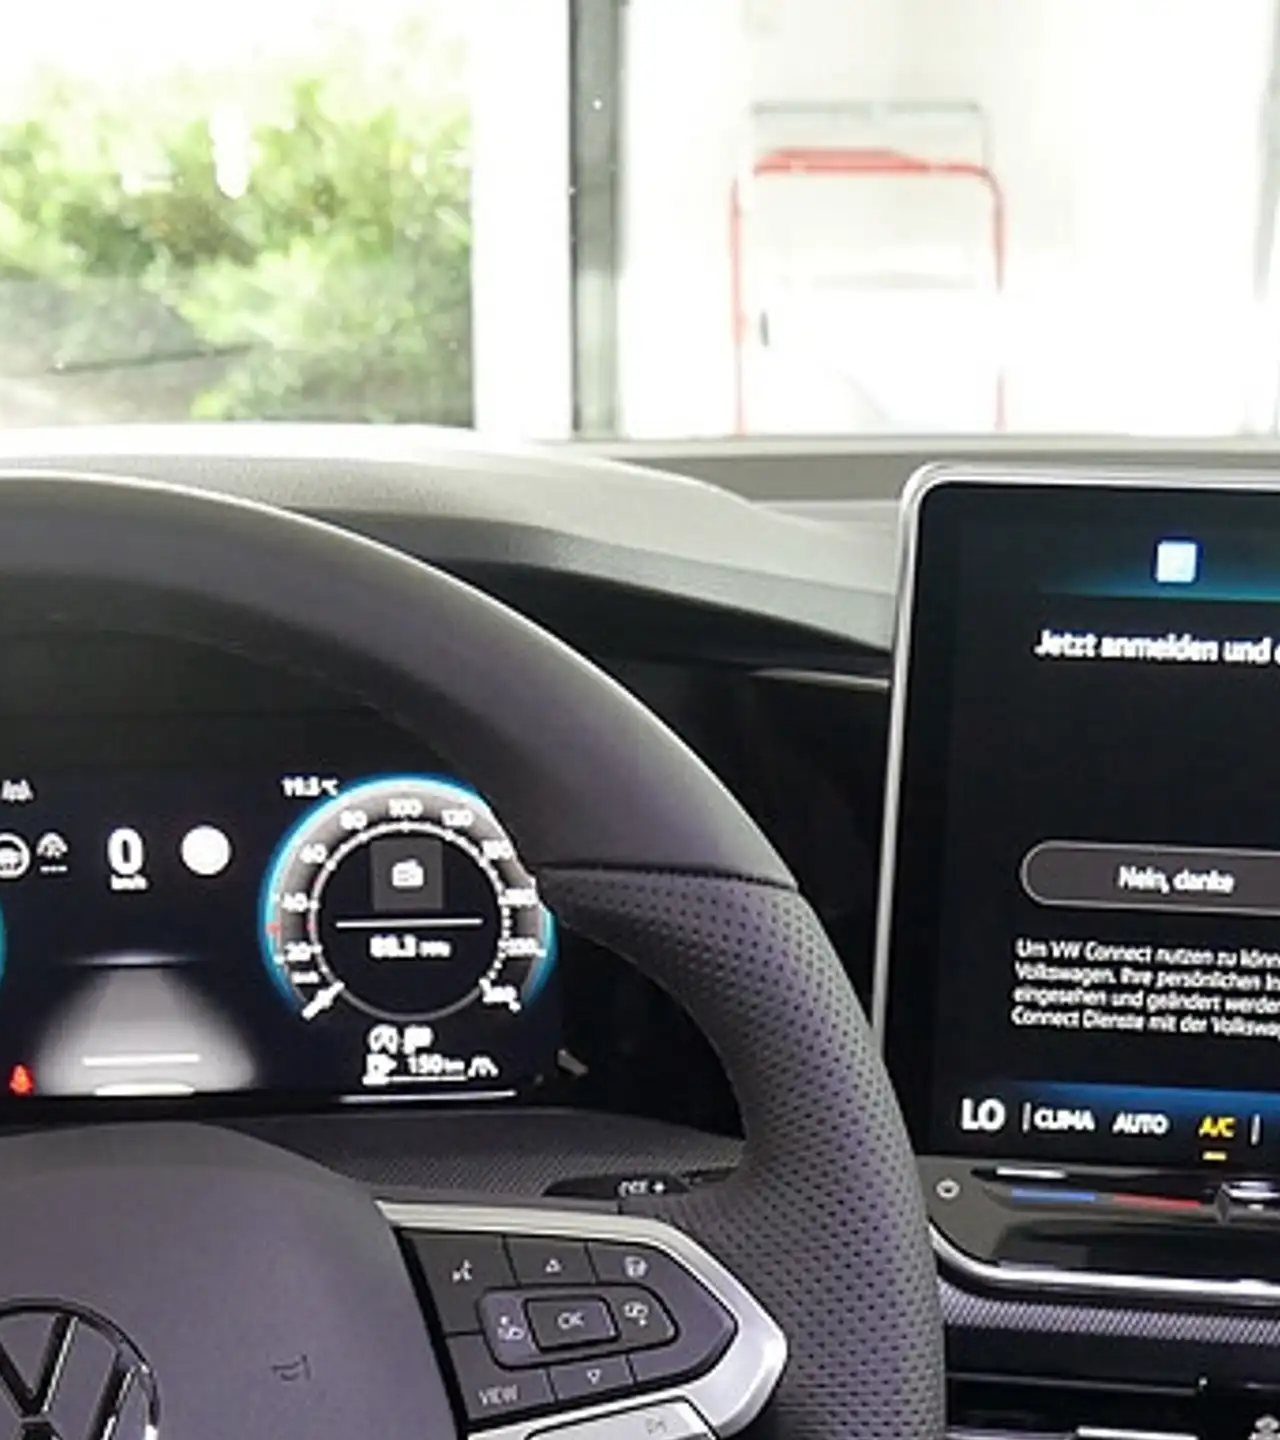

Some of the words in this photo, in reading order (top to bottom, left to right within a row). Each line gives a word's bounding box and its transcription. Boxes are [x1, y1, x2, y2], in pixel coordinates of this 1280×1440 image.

[1034, 630, 1096, 658] Jetzt
[1101, 635, 1219, 662] anmelden
[1223, 637, 1272, 665] und
[106, 826, 144, 876] 0
[1119, 864, 1170, 894] Nein,
[1172, 869, 1235, 894] danke
[961, 1098, 1005, 1132] LO
[1033, 1109, 1095, 1132] CLIMA
[1113, 1111, 1169, 1135] AUTO
[1198, 1116, 1237, 1139] A/C
[558, 1311, 586, 1330] OK
[479, 1384, 518, 1406] VIEW
